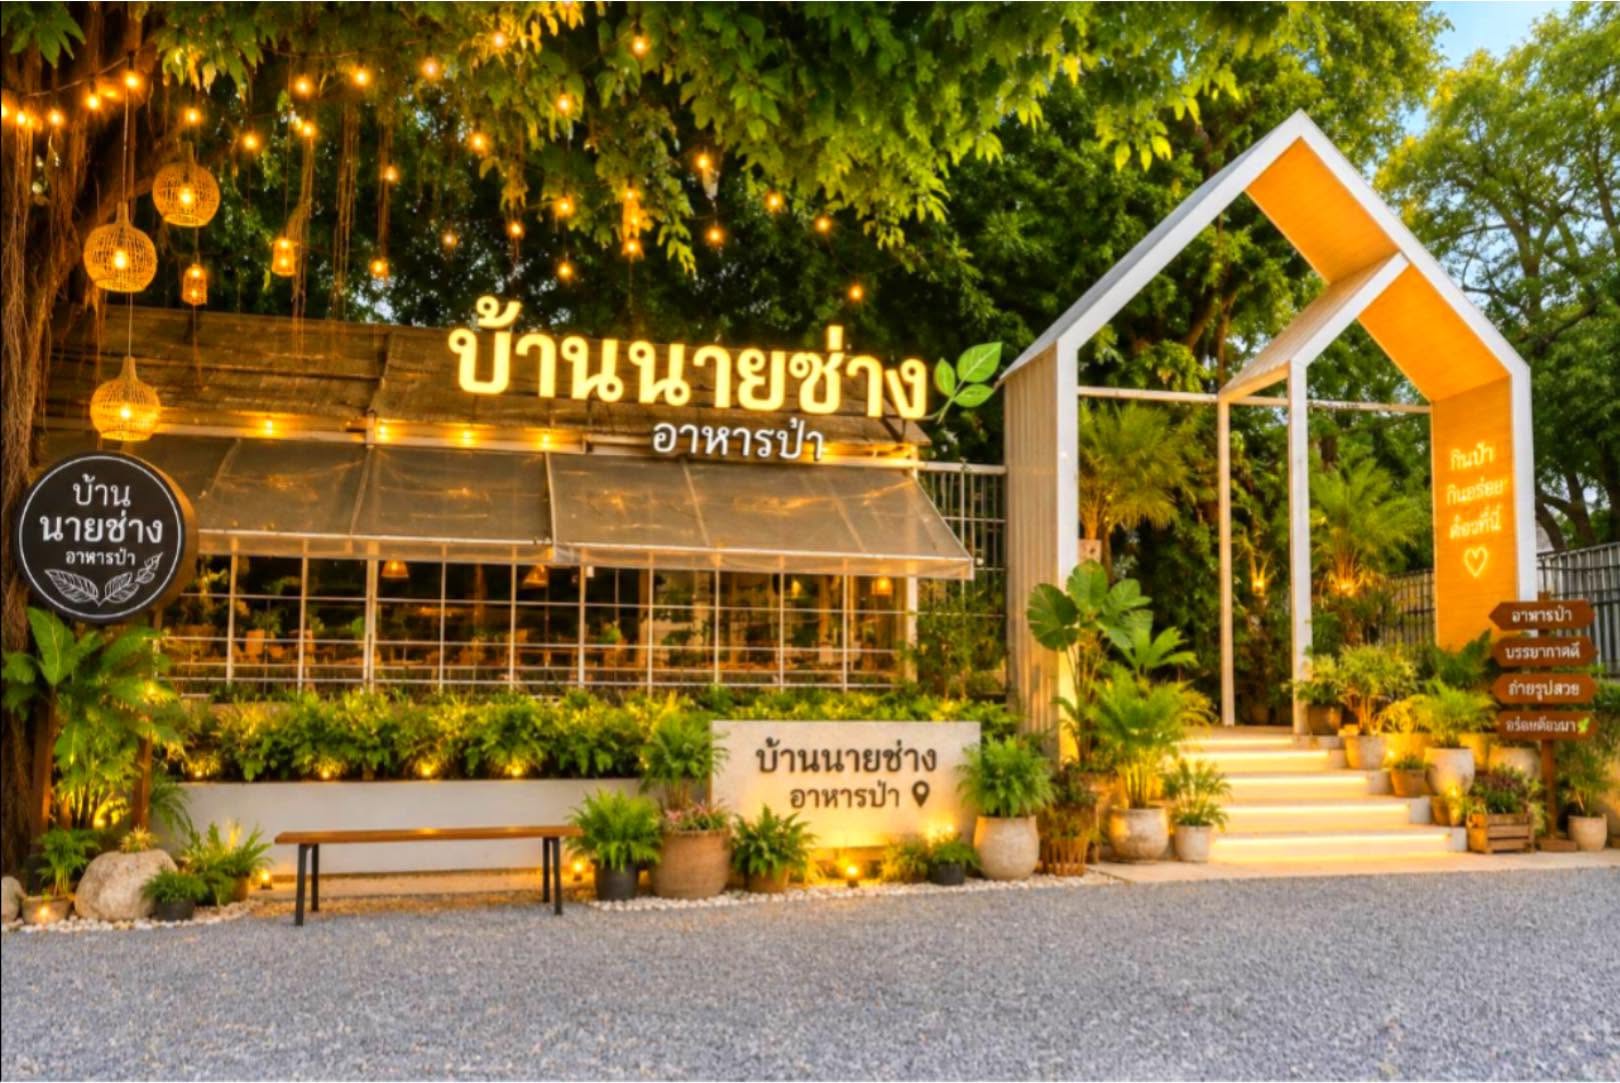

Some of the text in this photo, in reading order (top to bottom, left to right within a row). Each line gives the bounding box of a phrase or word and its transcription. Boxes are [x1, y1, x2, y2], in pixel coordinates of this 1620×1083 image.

[447, 295, 929, 420] บ้านนายช่าง
[652, 417, 825, 461] อาหารป่า
[72, 473, 131, 507] บ้าน
[39, 509, 164, 544] นายช่าง
[65, 548, 137, 566] อาหารป่า
[1511, 604, 1573, 623] อาหารป่า
[1505, 641, 1581, 660] บรรยากาศดี
[1508, 679, 1580, 701] ถ่ายรูปสวย
[755, 736, 938, 774] บ้านนายช่าง
[789, 779, 900, 809] อาหารป่า
